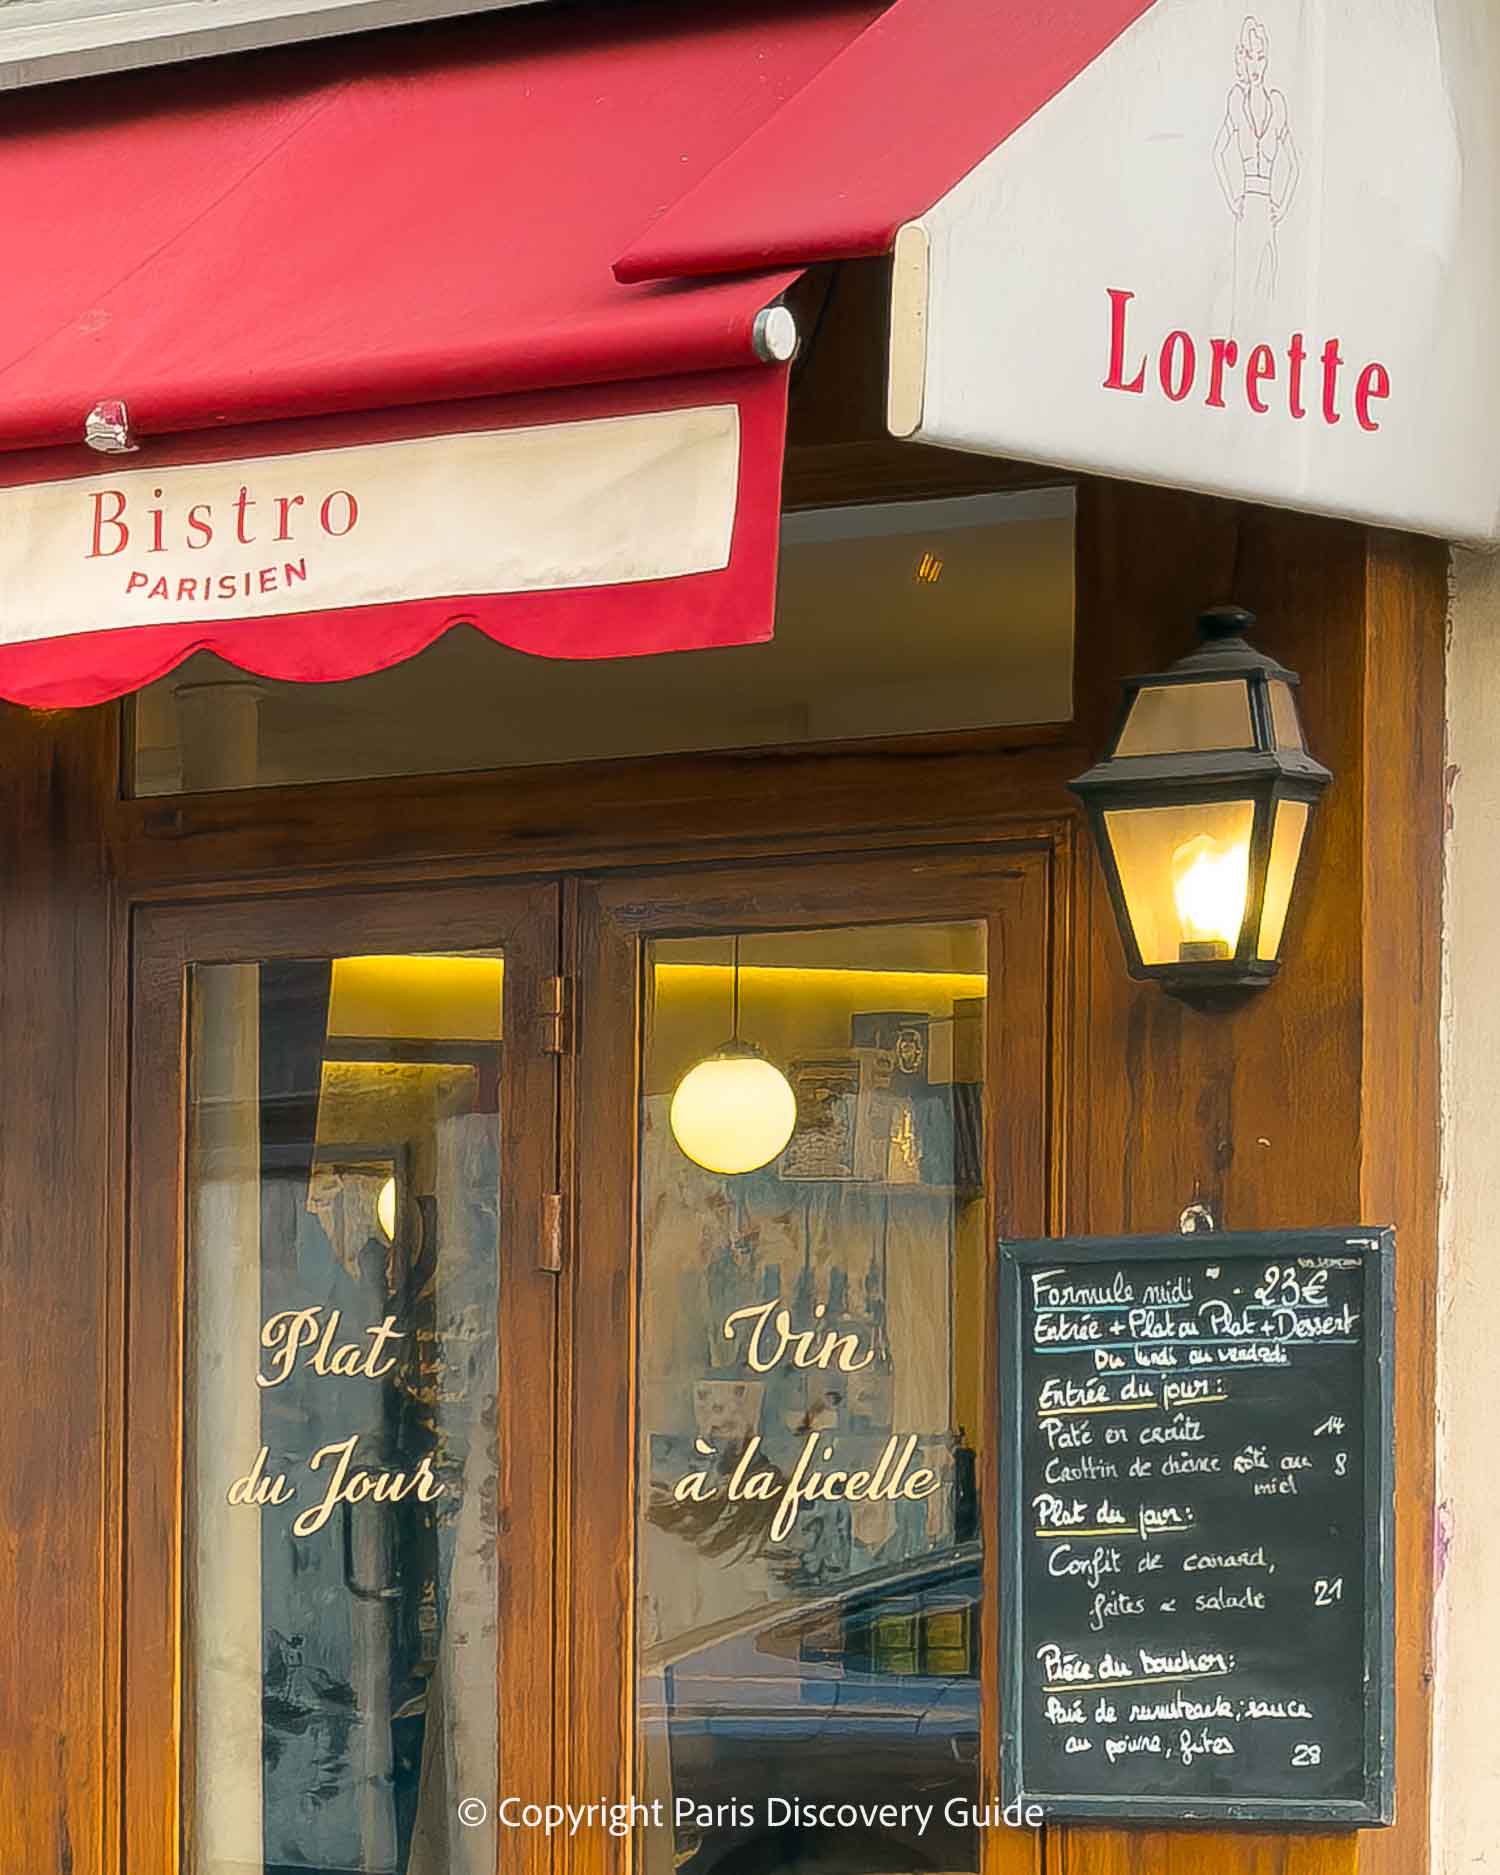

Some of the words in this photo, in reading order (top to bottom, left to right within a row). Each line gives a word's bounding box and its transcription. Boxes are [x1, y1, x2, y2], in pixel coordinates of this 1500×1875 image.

[1103, 288, 1390, 432] Lorette
[84, 487, 360, 559] Bistro
[125, 558, 308, 602] PARISIEN
[1032, 1269, 1135, 1306] Formule
[1142, 1277, 1193, 1305] midi
[1254, 1266, 1328, 1307] 23€
[723, 1299, 874, 1374] Vin
[1033, 1314, 1103, 1343] Entrée
[1128, 1307, 1175, 1338] Plat
[1198, 1299, 1255, 1337] Plat
[1272, 1303, 1359, 1344] Dessert
[255, 1305, 404, 1388] Plat
[1093, 1349, 1126, 1371] Du
[1188, 1349, 1214, 1366] au
[1037, 1377, 1110, 1409] Entrée
[1120, 1375, 1154, 1399] du
[1104, 1430, 1129, 1444] en
[1312, 1415, 1346, 1437] 14
[1045, 1455, 1119, 1486] Crottin
[1128, 1455, 1153, 1478] de
[1334, 1452, 1349, 1478] 8
[228, 1446, 295, 1506] du
[292, 1434, 446, 1537] Jour
[674, 1437, 720, 1502] à
[724, 1434, 782, 1502] la
[770, 1432, 942, 1543] ficelle
[1253, 1473, 1298, 1496] miel
[1032, 1494, 1088, 1528] Plat
[1096, 1499, 1126, 1525] du
[1049, 1545, 1120, 1588] Confit
[1137, 1553, 1163, 1574] de
[1088, 1590, 1145, 1632] frites
[1195, 1586, 1266, 1612] salade
[1312, 1578, 1343, 1606] 21
[1099, 1653, 1133, 1679] du
[1095, 1697, 1118, 1723] de
[1065, 1737, 1092, 1753] au
